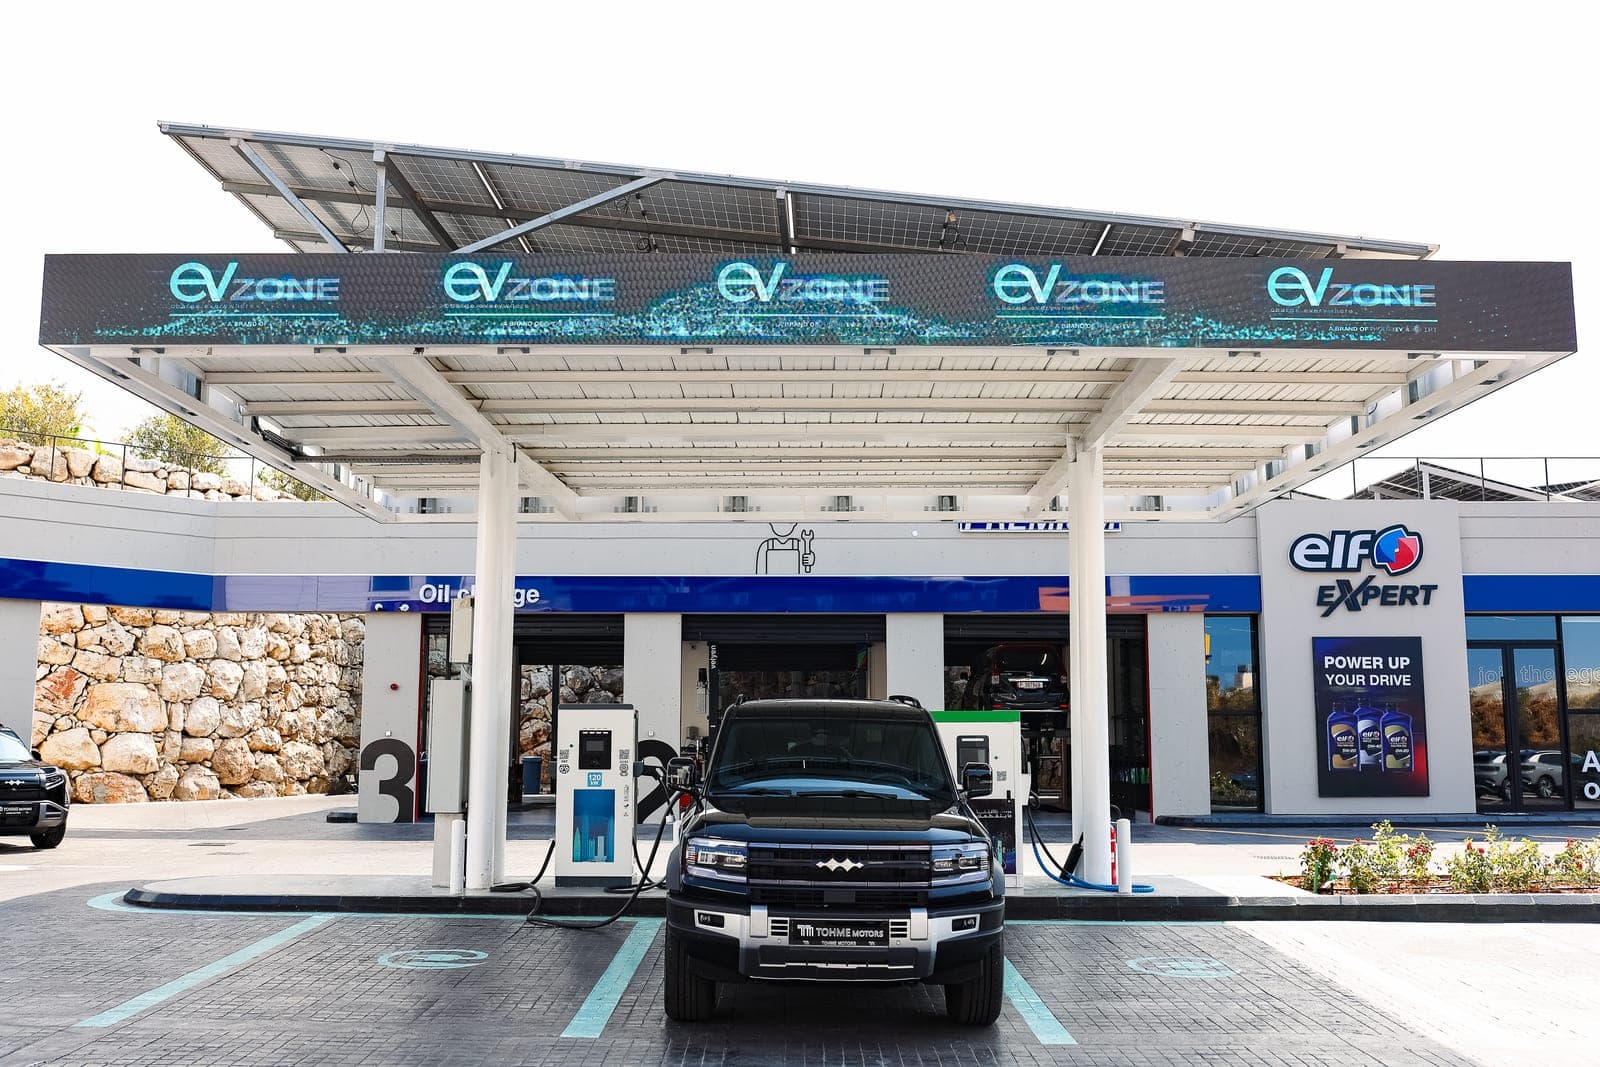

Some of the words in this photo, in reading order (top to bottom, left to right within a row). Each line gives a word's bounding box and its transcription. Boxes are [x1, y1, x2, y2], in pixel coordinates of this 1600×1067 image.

[1290, 531, 1375, 571] elf
[419, 584, 451, 603] Oil
[1316, 575, 1438, 617] EXPERT
[1324, 656, 1384, 669] POWER
[1388, 656, 1410, 669] UP
[1325, 674, 1366, 686] YOUR
[1369, 674, 1412, 686] DRIVE
[360, 739, 415, 823] 3
[816, 928, 851, 938] TOHME
[852, 929, 884, 938] MOTORS
